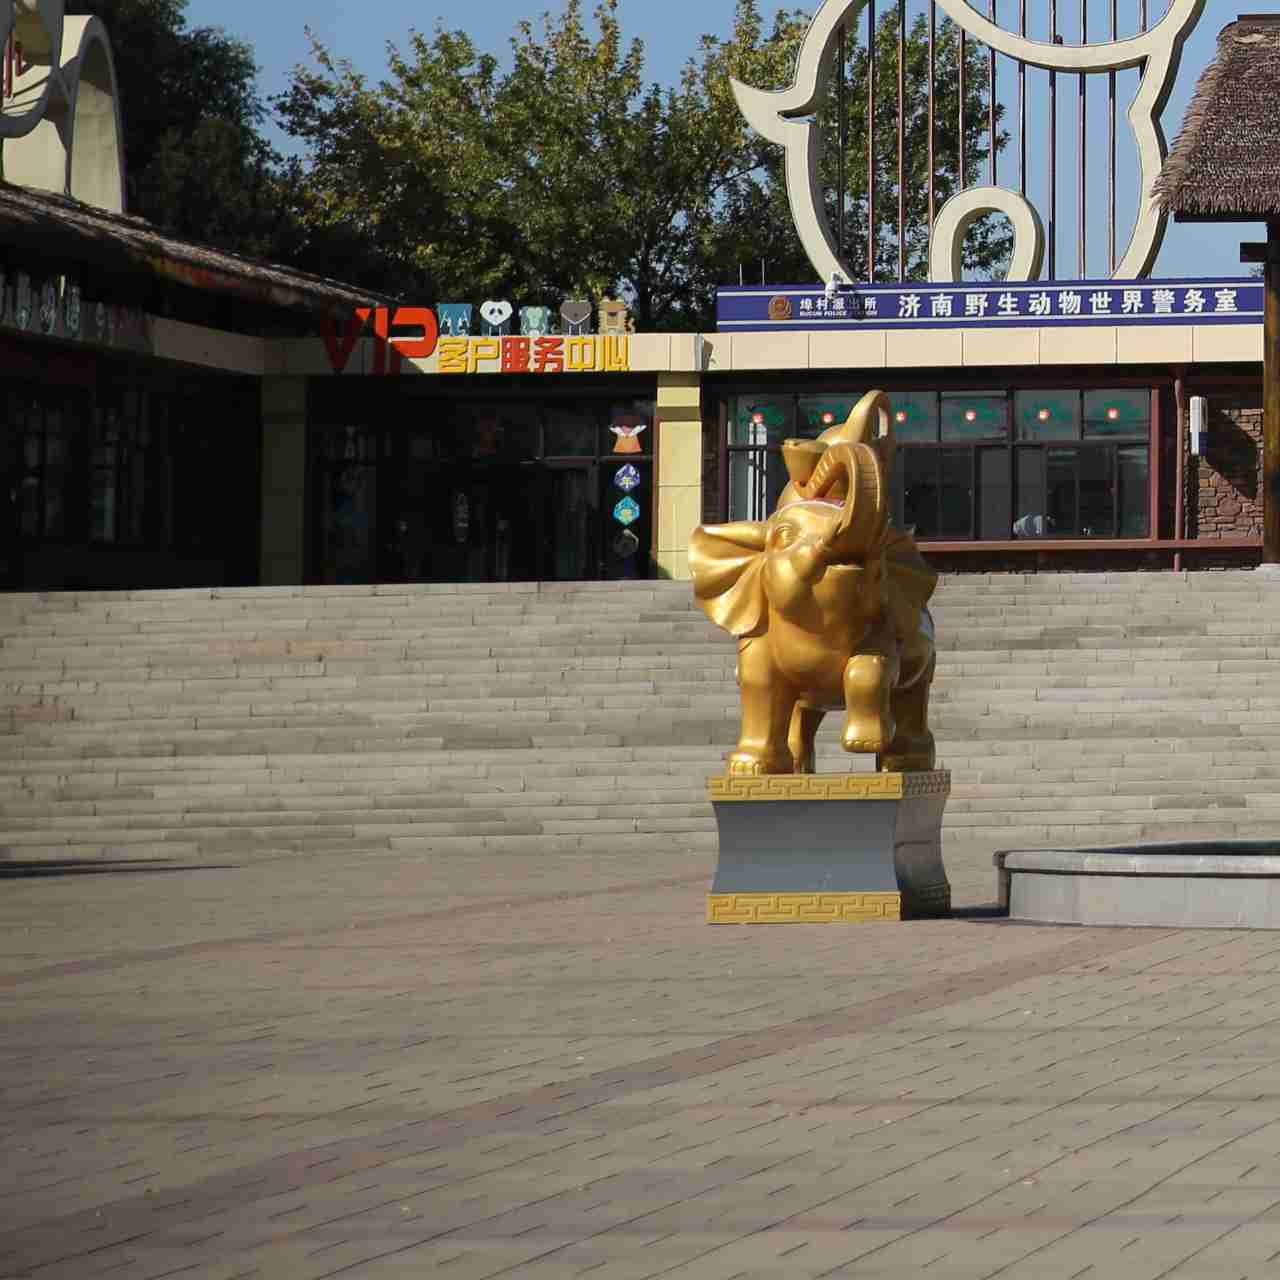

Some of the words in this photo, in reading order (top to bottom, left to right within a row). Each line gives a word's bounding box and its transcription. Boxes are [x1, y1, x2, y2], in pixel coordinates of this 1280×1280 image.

[898, 288, 1239, 318] 济南野生动物世界警务室
[437, 335, 633, 373] 客户服务中心
